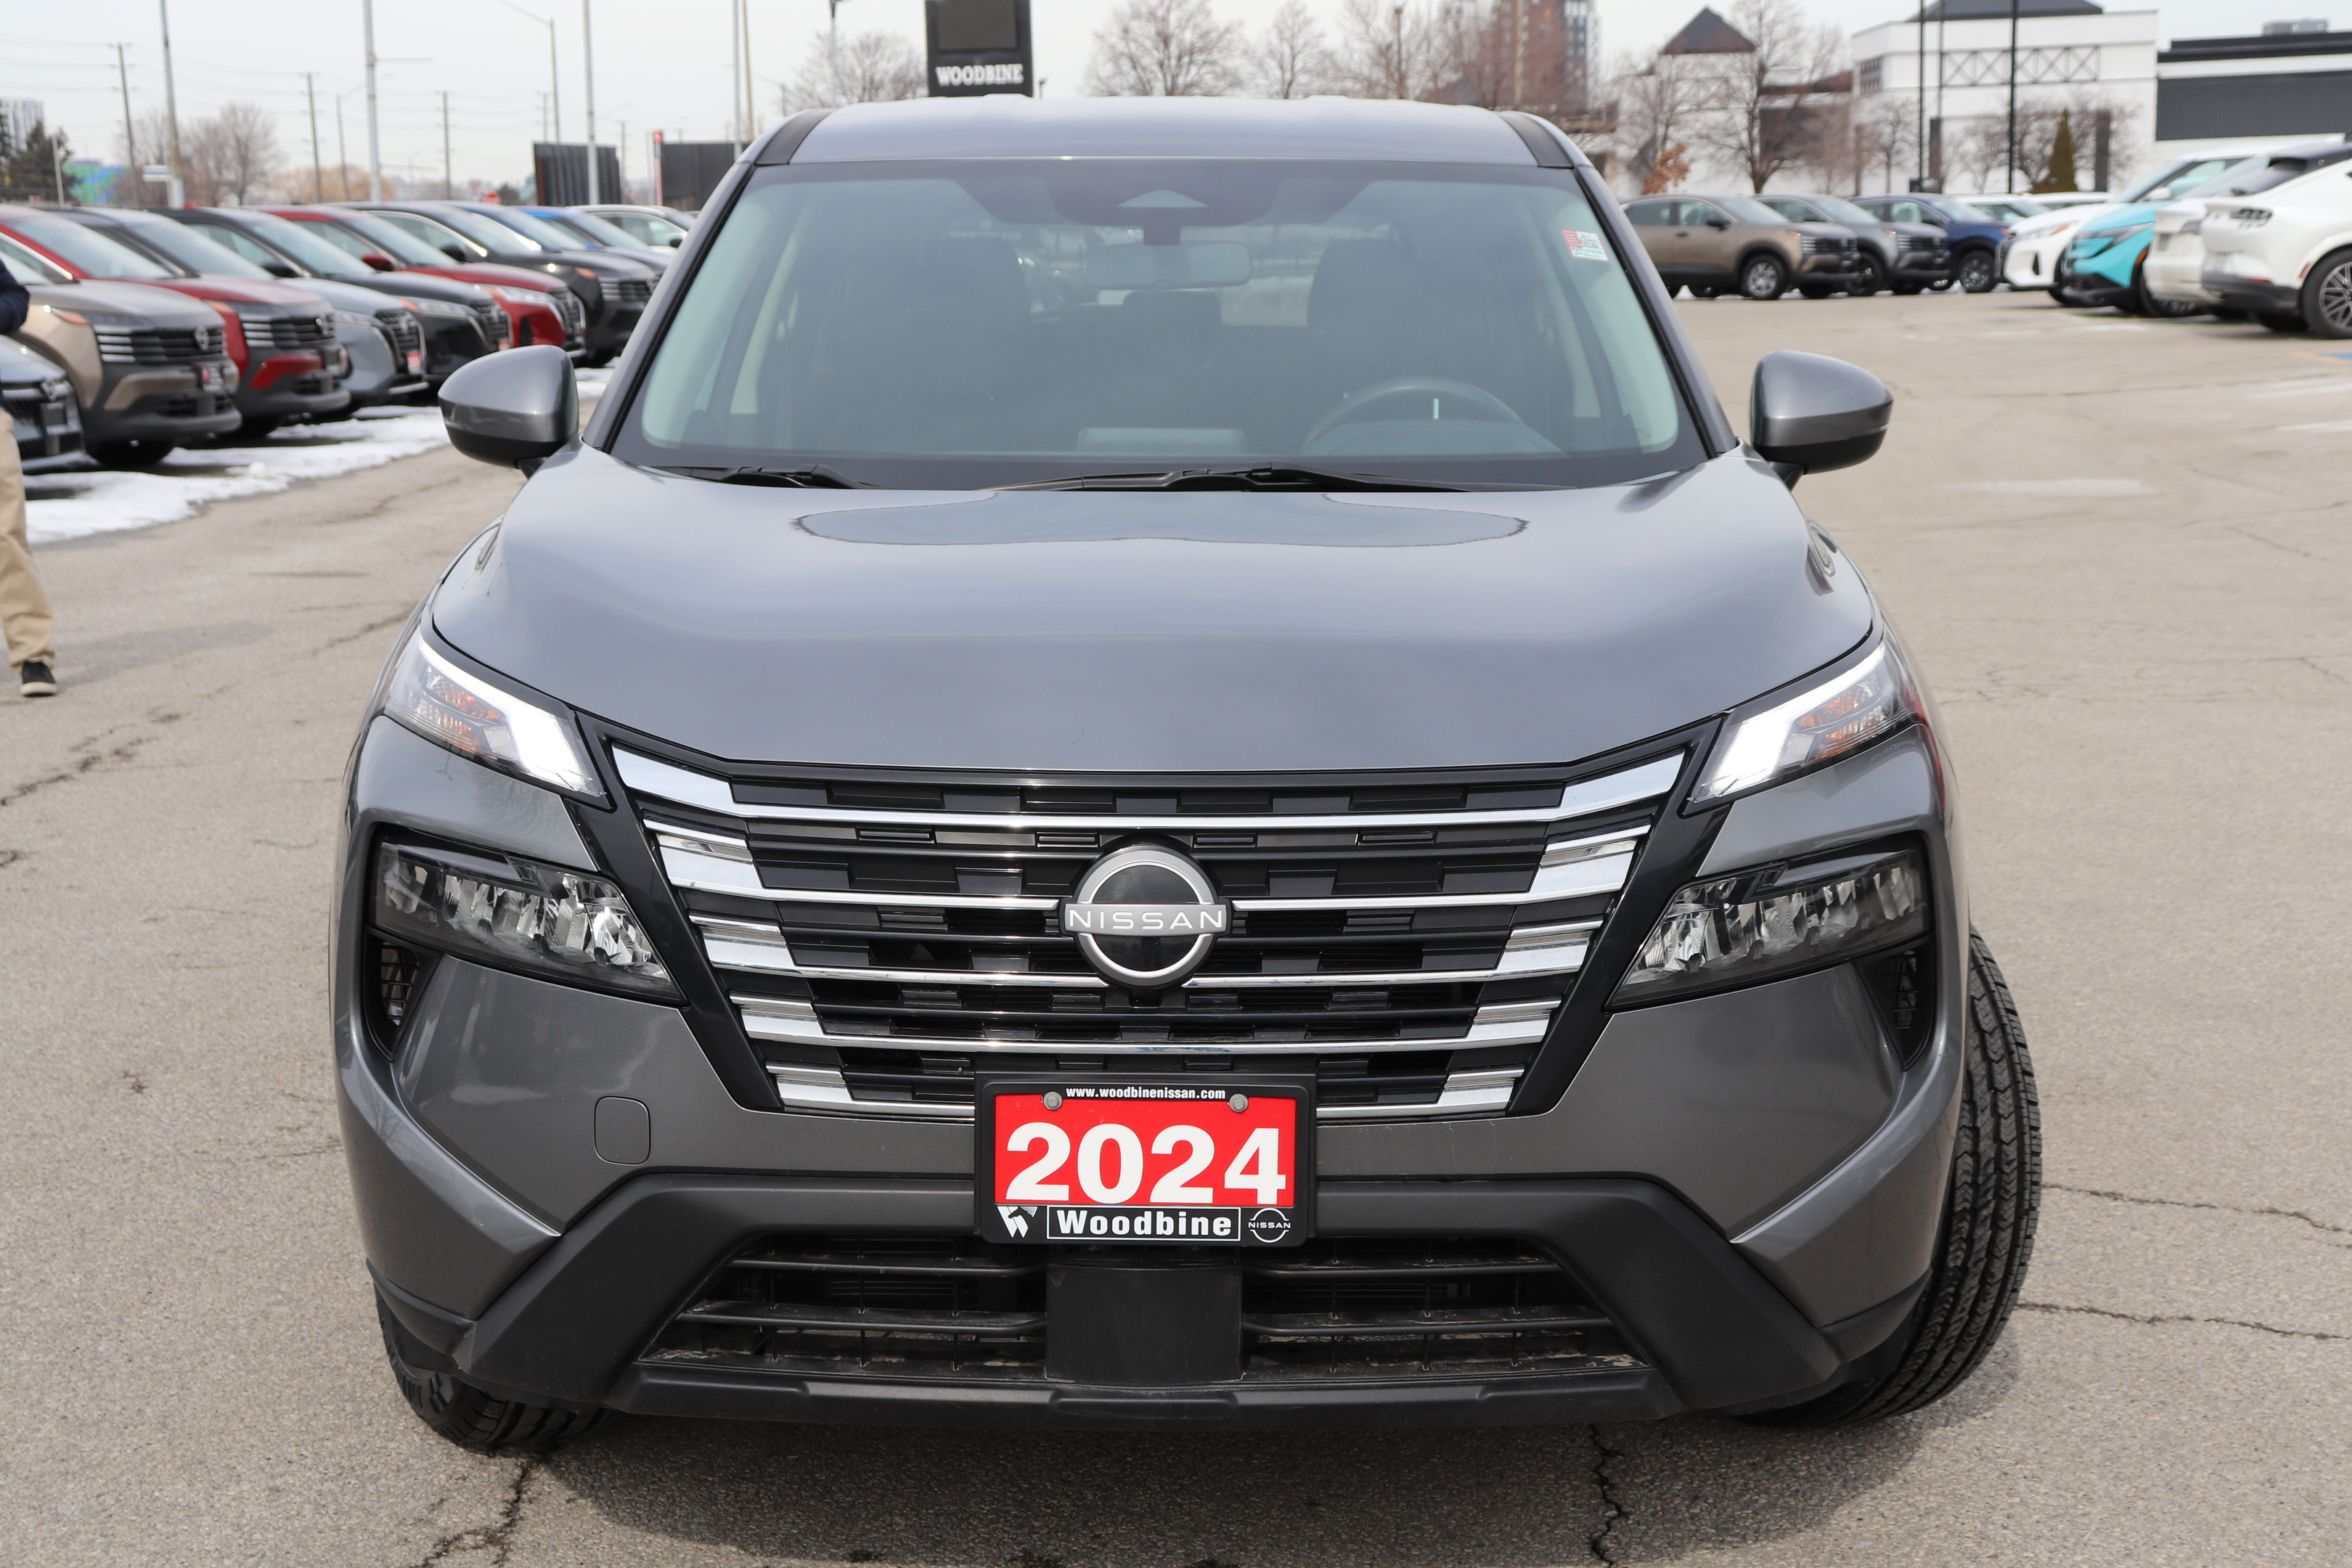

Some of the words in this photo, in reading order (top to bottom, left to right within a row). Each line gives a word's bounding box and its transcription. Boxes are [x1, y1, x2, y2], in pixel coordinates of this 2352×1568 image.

[935, 63, 1024, 86] WOODBINE
[1069, 908, 1222, 930] NISSAN
[1065, 1086, 1226, 1099] www.woodbinenissan.com
[1005, 1122, 1286, 1205] 2024
[1056, 1209, 1232, 1236] Woodbine
